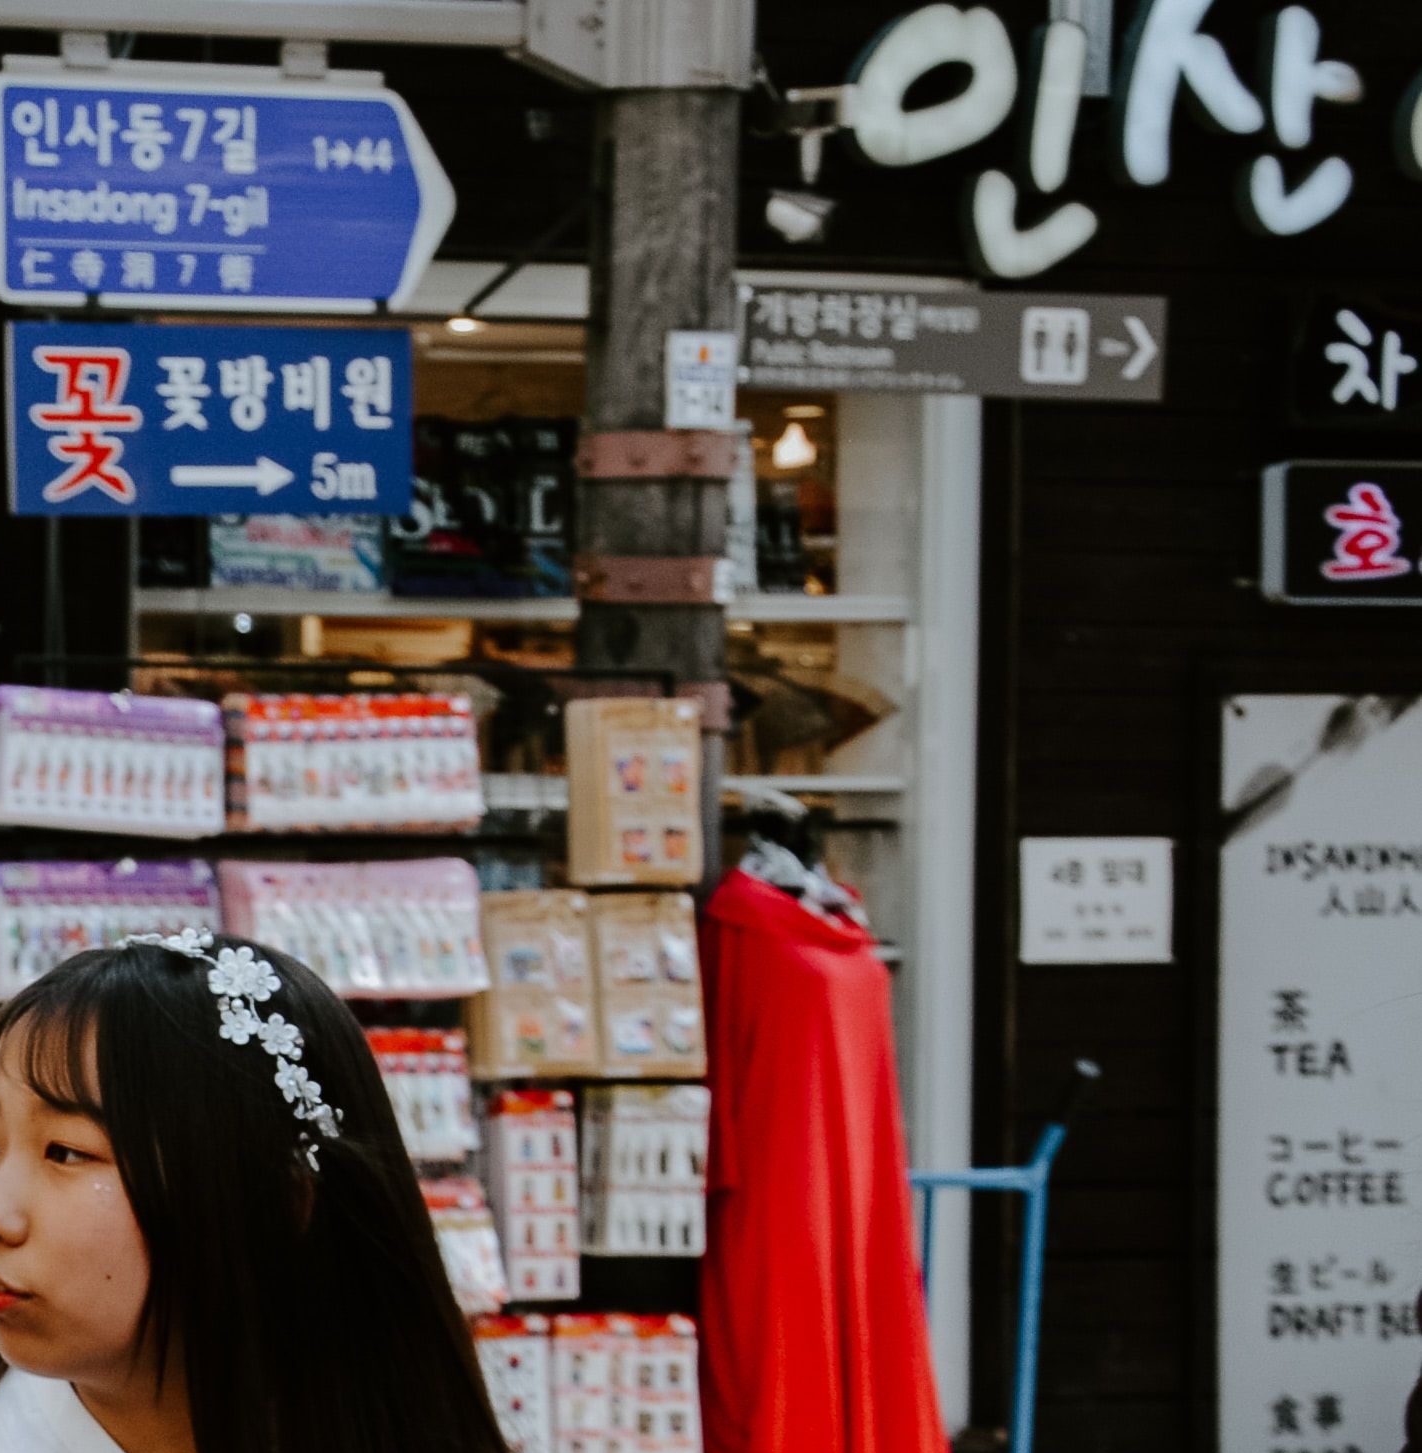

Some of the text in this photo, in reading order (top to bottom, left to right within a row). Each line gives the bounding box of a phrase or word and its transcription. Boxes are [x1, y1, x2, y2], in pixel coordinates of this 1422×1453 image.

[12, 99, 257, 175] 인사동7길
[853, 0, 1422, 279] 인산
[12, 176, 270, 238] Insadong 7-gil
[1324, 308, 1418, 411] 차
[156, 354, 394, 432] 꽃방비원
[31, 345, 143, 504] 꽃
[309, 452, 378, 500] 5m
[1319, 481, 1422, 582] 호
[1268, 1040, 1353, 1079] TEA
[1268, 1131, 1404, 1165] コーヒー
[1265, 1171, 1407, 1208] COFFEE
[1270, 1253, 1395, 1296] 生ビール
[1269, 1301, 1422, 1341] DRAFT BE
